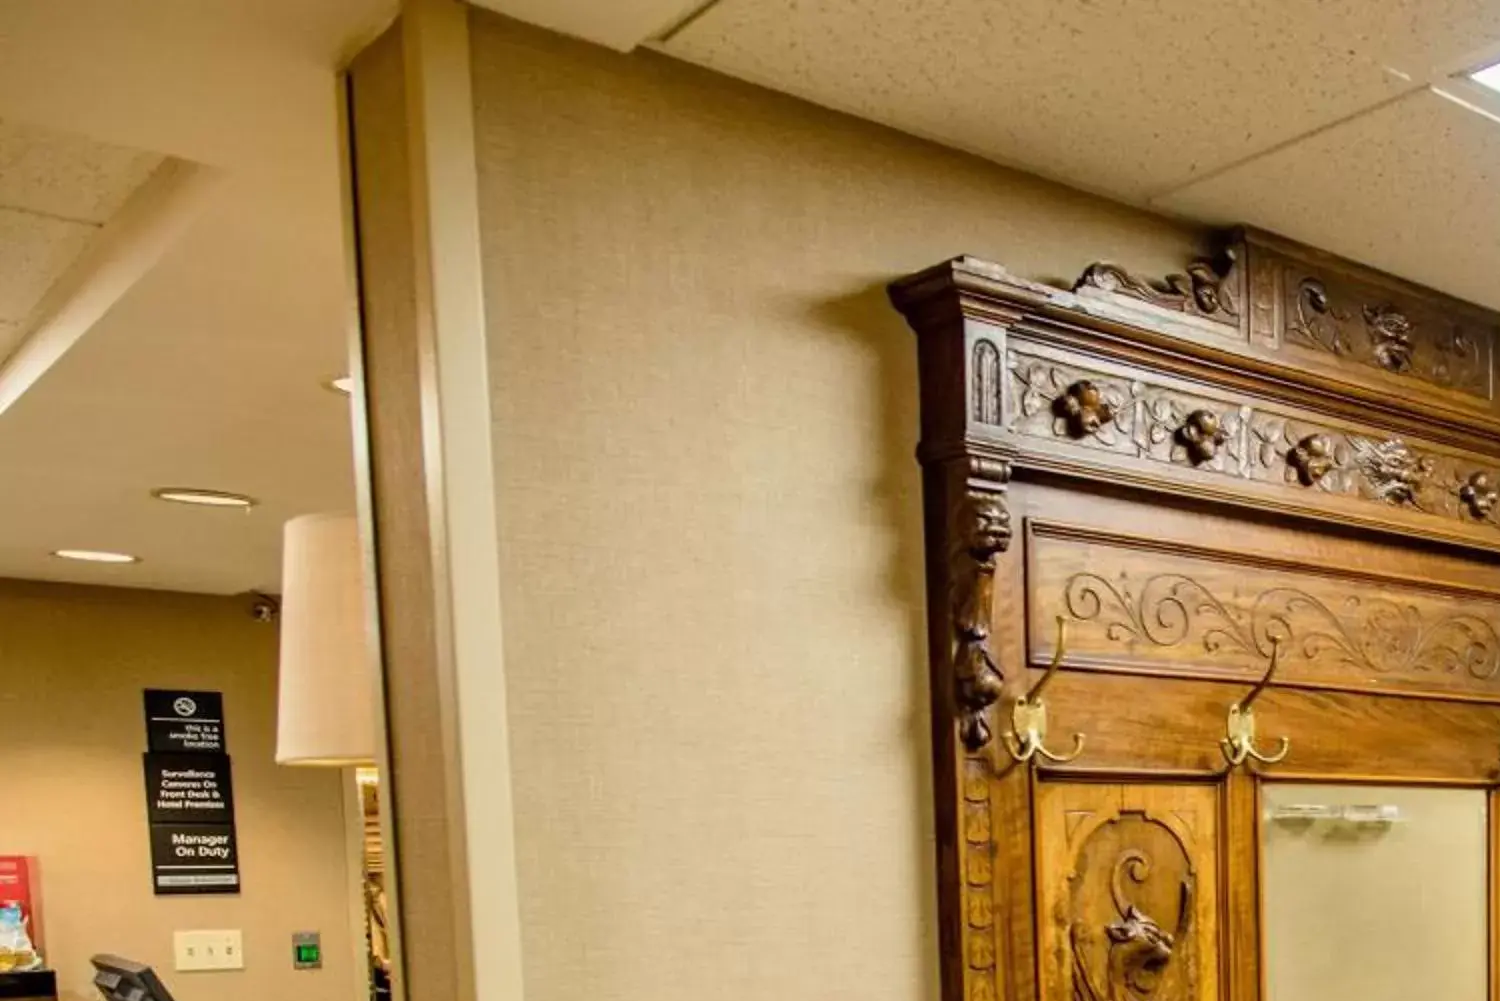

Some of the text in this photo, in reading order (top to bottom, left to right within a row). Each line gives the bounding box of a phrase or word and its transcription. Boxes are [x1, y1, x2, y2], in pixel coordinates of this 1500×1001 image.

[160, 789, 185, 799] Front
[187, 789, 210, 799] Desk
[172, 833, 229, 846] Manager
[175, 846, 230, 859] On Duty
